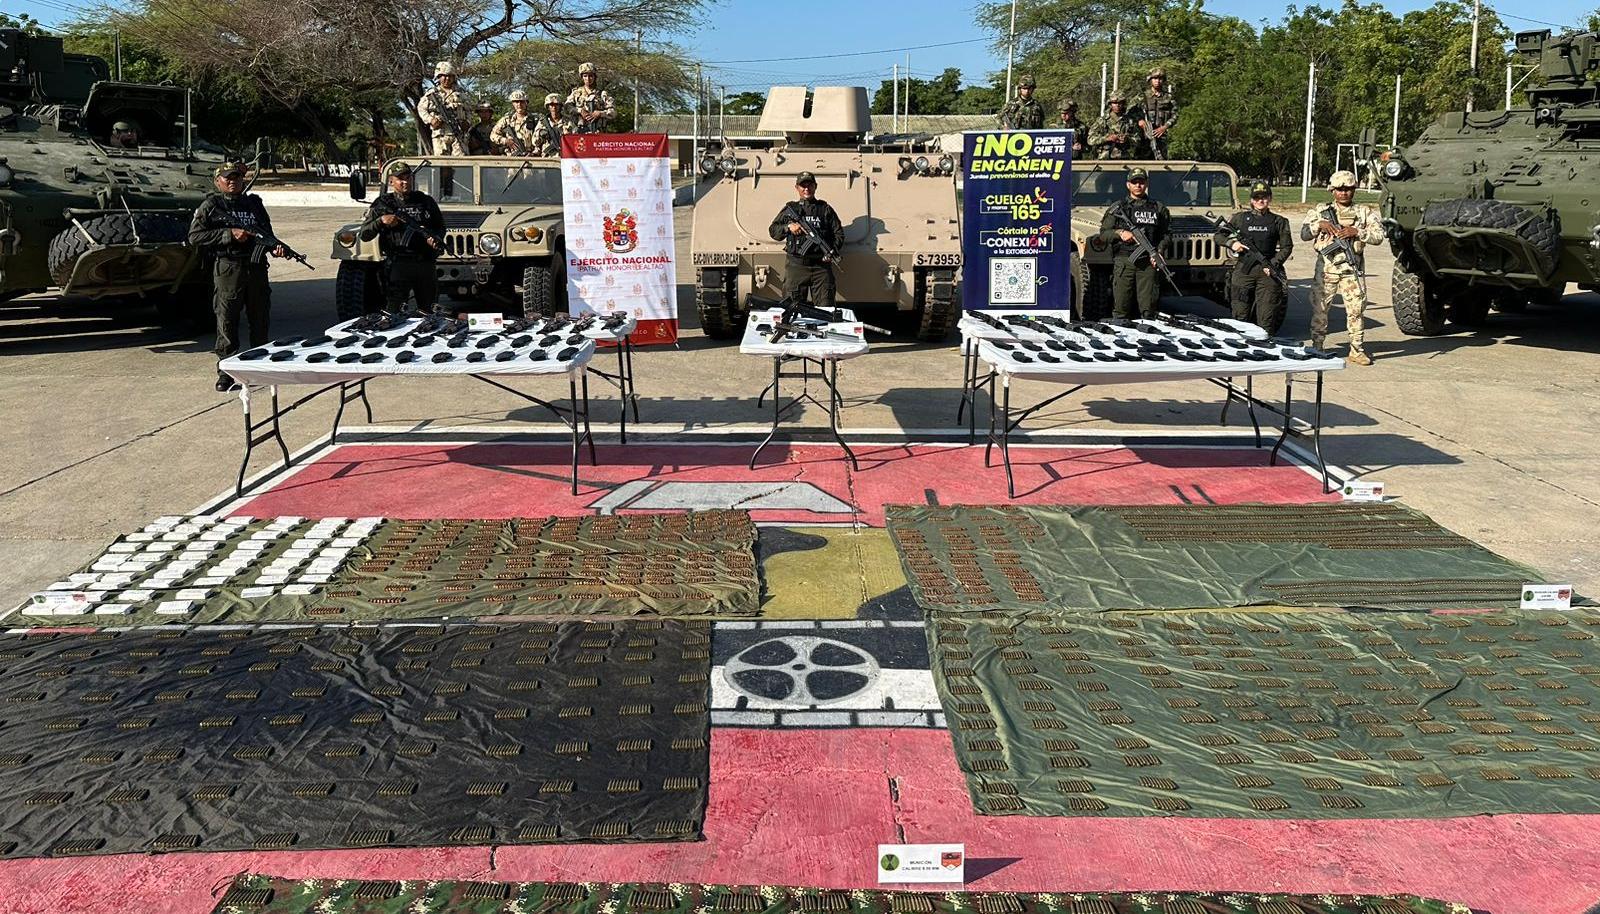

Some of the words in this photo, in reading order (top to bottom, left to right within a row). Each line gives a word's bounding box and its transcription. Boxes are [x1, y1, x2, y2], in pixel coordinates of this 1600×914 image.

[973, 133, 1032, 156] ¡NO
[1034, 136, 1066, 145] DEJES
[1033, 145, 1053, 155] QUE
[1054, 145, 1065, 153] TE
[989, 172, 1028, 180] prevenimos
[985, 194, 1032, 205] CUELGA
[1011, 204, 1041, 220] 165
[1134, 210, 1158, 219] GAULA
[997, 227, 1029, 235] Córtale
[1029, 227, 1038, 235] la
[986, 235, 1047, 248] CONEXIÓN
[1005, 247, 1039, 255] EXTORSIÓN
[570, 257, 619, 266] EJÉRCITO
[622, 256, 673, 265] NACIONAL
[917, 254, 961, 265] S-73953
[577, 265, 604, 273] PATRIA
[634, 263, 664, 271] LEALTAD
